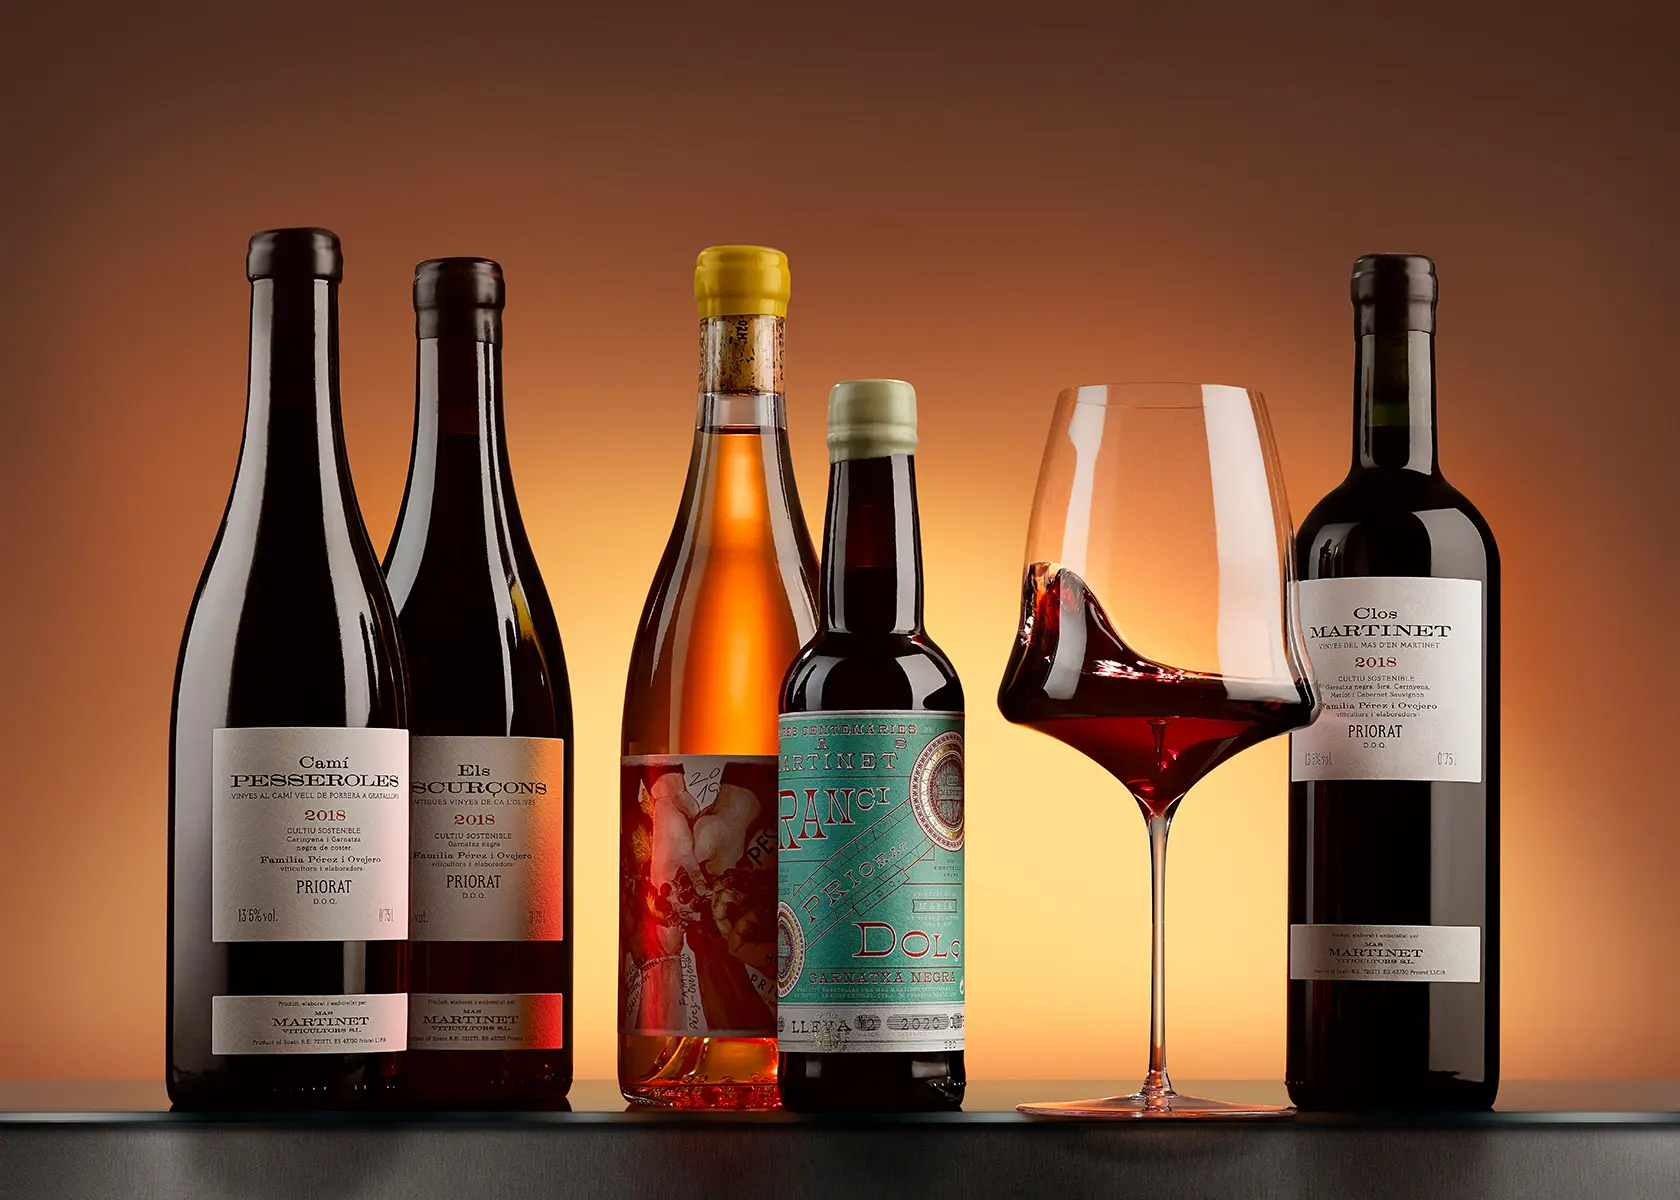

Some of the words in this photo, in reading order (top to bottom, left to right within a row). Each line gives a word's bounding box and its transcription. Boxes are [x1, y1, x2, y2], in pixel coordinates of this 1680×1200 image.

[1353, 607, 1398, 620] Clos
[1310, 625, 1452, 638] MARTINET
[1355, 657, 1397, 668] 2018
[1390, 691, 1424, 699] Sauvignon
[1359, 701, 1388, 709] Pérez
[1398, 702, 1437, 711] Ovejero
[1348, 724, 1403, 738] PRIORAT
[299, 756, 349, 769] Camí
[457, 764, 491, 776] Els
[689, 767, 721, 786] 20
[230, 774, 399, 787] PESSEROLES
[231, 792, 257, 800] VINYES
[259, 792, 270, 800] AL
[272, 791, 293, 799] CAMÍ
[362, 792, 367, 800] A
[412, 782, 547, 797] SCURÇONS
[697, 782, 722, 803] 19
[304, 810, 346, 821] 2018
[453, 814, 495, 826] 2018
[286, 836, 323, 844] Carinyena
[308, 855, 338, 863] Pérez
[347, 856, 381, 866] Ovejero
[457, 851, 487, 859] Pérez
[497, 852, 532, 861] Ovejero
[296, 880, 352, 894] PRIORAT
[446, 875, 501, 888] PRIORAT
[801, 842, 907, 924] PRIORAT
[263, 908, 278, 922] vol.
[1329, 949, 1423, 958] MARTINET
[808, 971, 905, 985] GARNATXA
[911, 971, 957, 984] NEGRA
[272, 1017, 369, 1026] MARTINET
[423, 1016, 518, 1024] MARTINET
[901, 1018, 940, 1031] 2020
